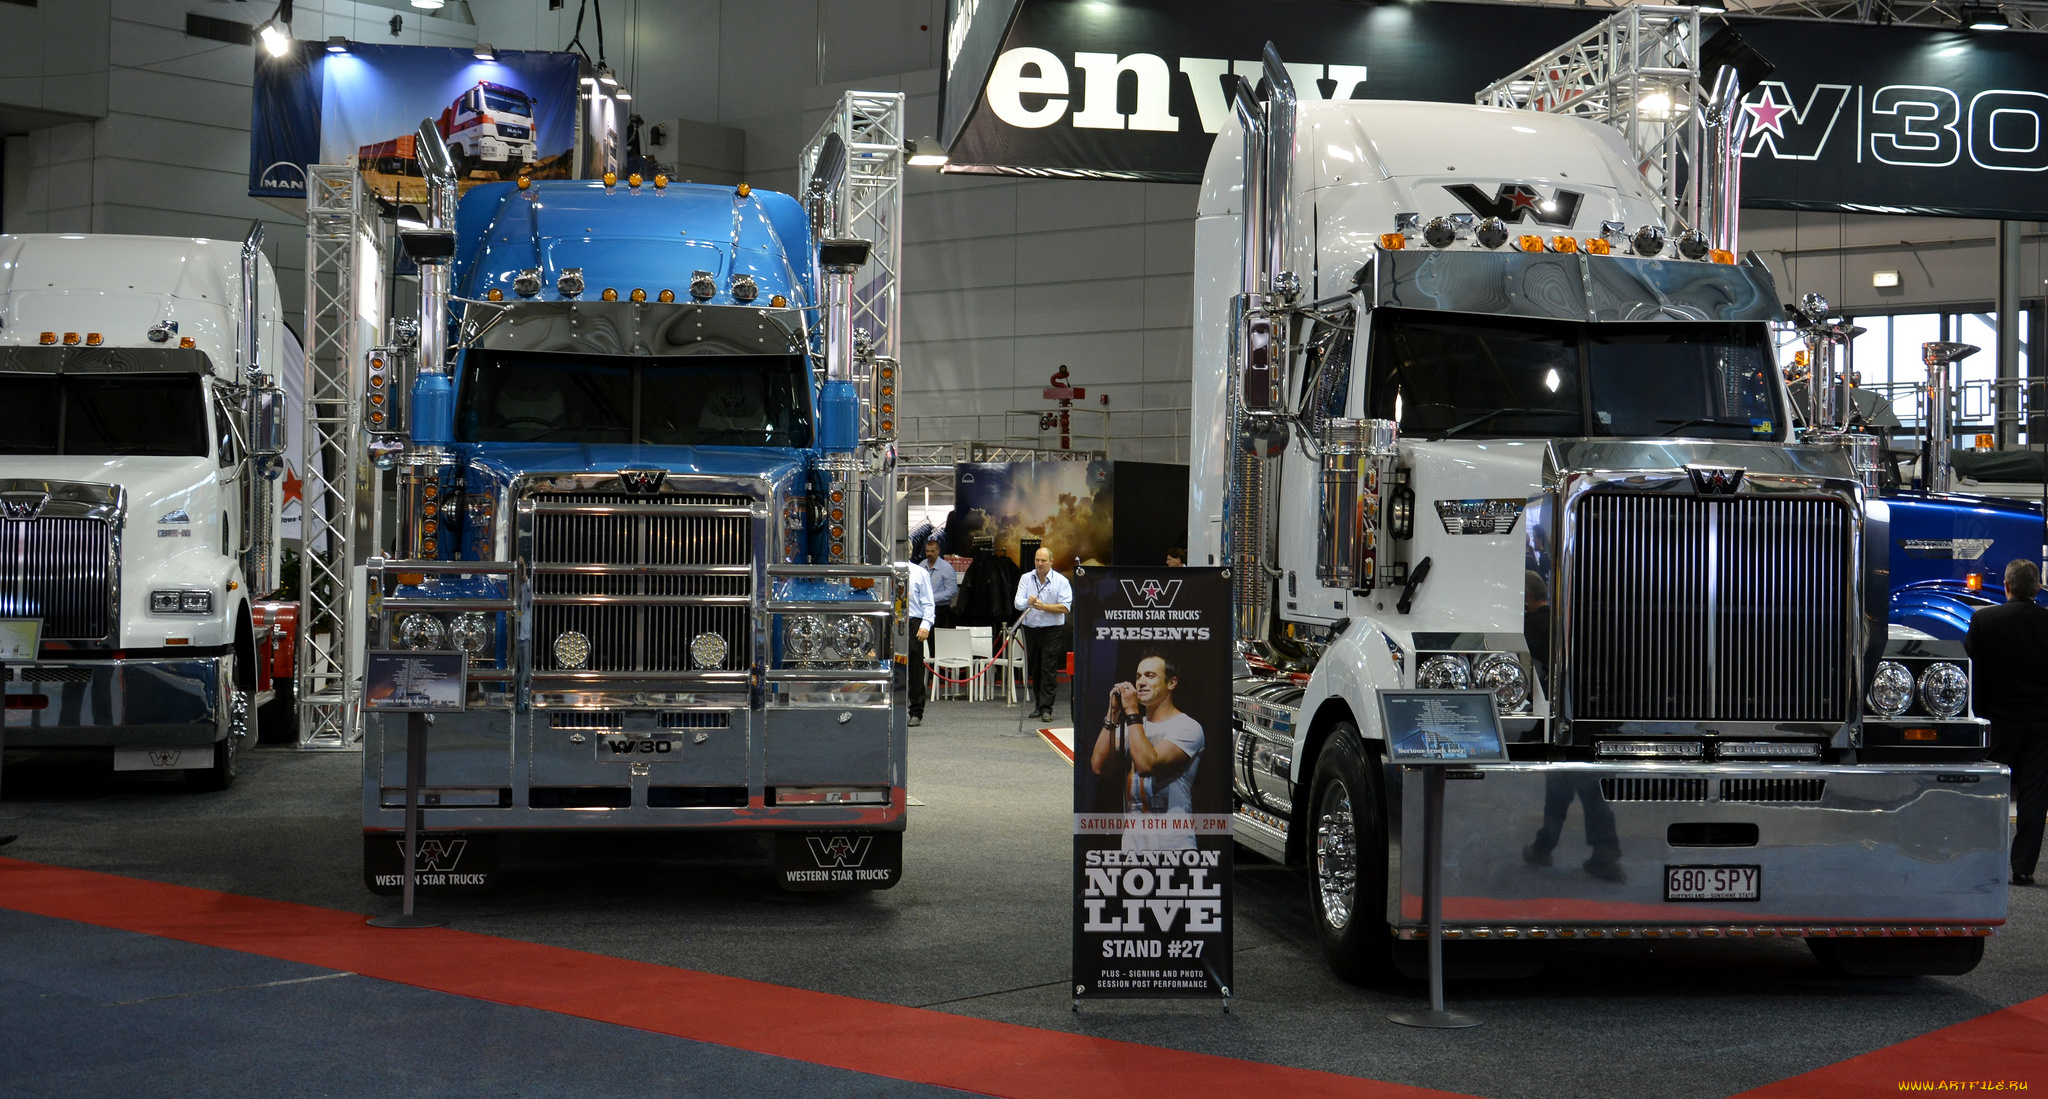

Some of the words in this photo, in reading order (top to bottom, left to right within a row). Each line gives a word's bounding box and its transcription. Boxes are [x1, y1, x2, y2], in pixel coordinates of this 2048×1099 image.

[264, 180, 304, 189] MAN
[1104, 610, 1143, 620] WESTERN
[1145, 610, 1166, 620] STAR
[1168, 610, 1200, 620] TRUCKS
[1095, 627, 1211, 640] PRESENTS
[1080, 818, 1136, 830] SATURDAY
[1141, 818, 1167, 830] 18TH
[1172, 818, 1198, 830] MAY,
[1203, 818, 1226, 830] 2PM
[1085, 850, 1221, 867] SHANNON
[423, 874, 446, 885] STAR
[449, 873, 485, 885] TRUCKS
[786, 870, 829, 882] WESTERN
[831, 870, 853, 881] STAR
[855, 869, 889, 880] TRUCKS
[1084, 868, 1222, 897] NOLL
[1084, 899, 1223, 933] LIVE
[1102, 939, 1162, 958] STAND
[1167, 939, 1205, 958] #27
[1101, 970, 1120, 978] PLUS
[1128, 970, 1160, 978] SIGNING
[1162, 970, 1178, 978] AND
[1180, 970, 1204, 978] PHOTO
[1097, 980, 1130, 988] SESSION
[1132, 980, 1151, 988] POST
[1153, 980, 1208, 988] PERFORMANCE
